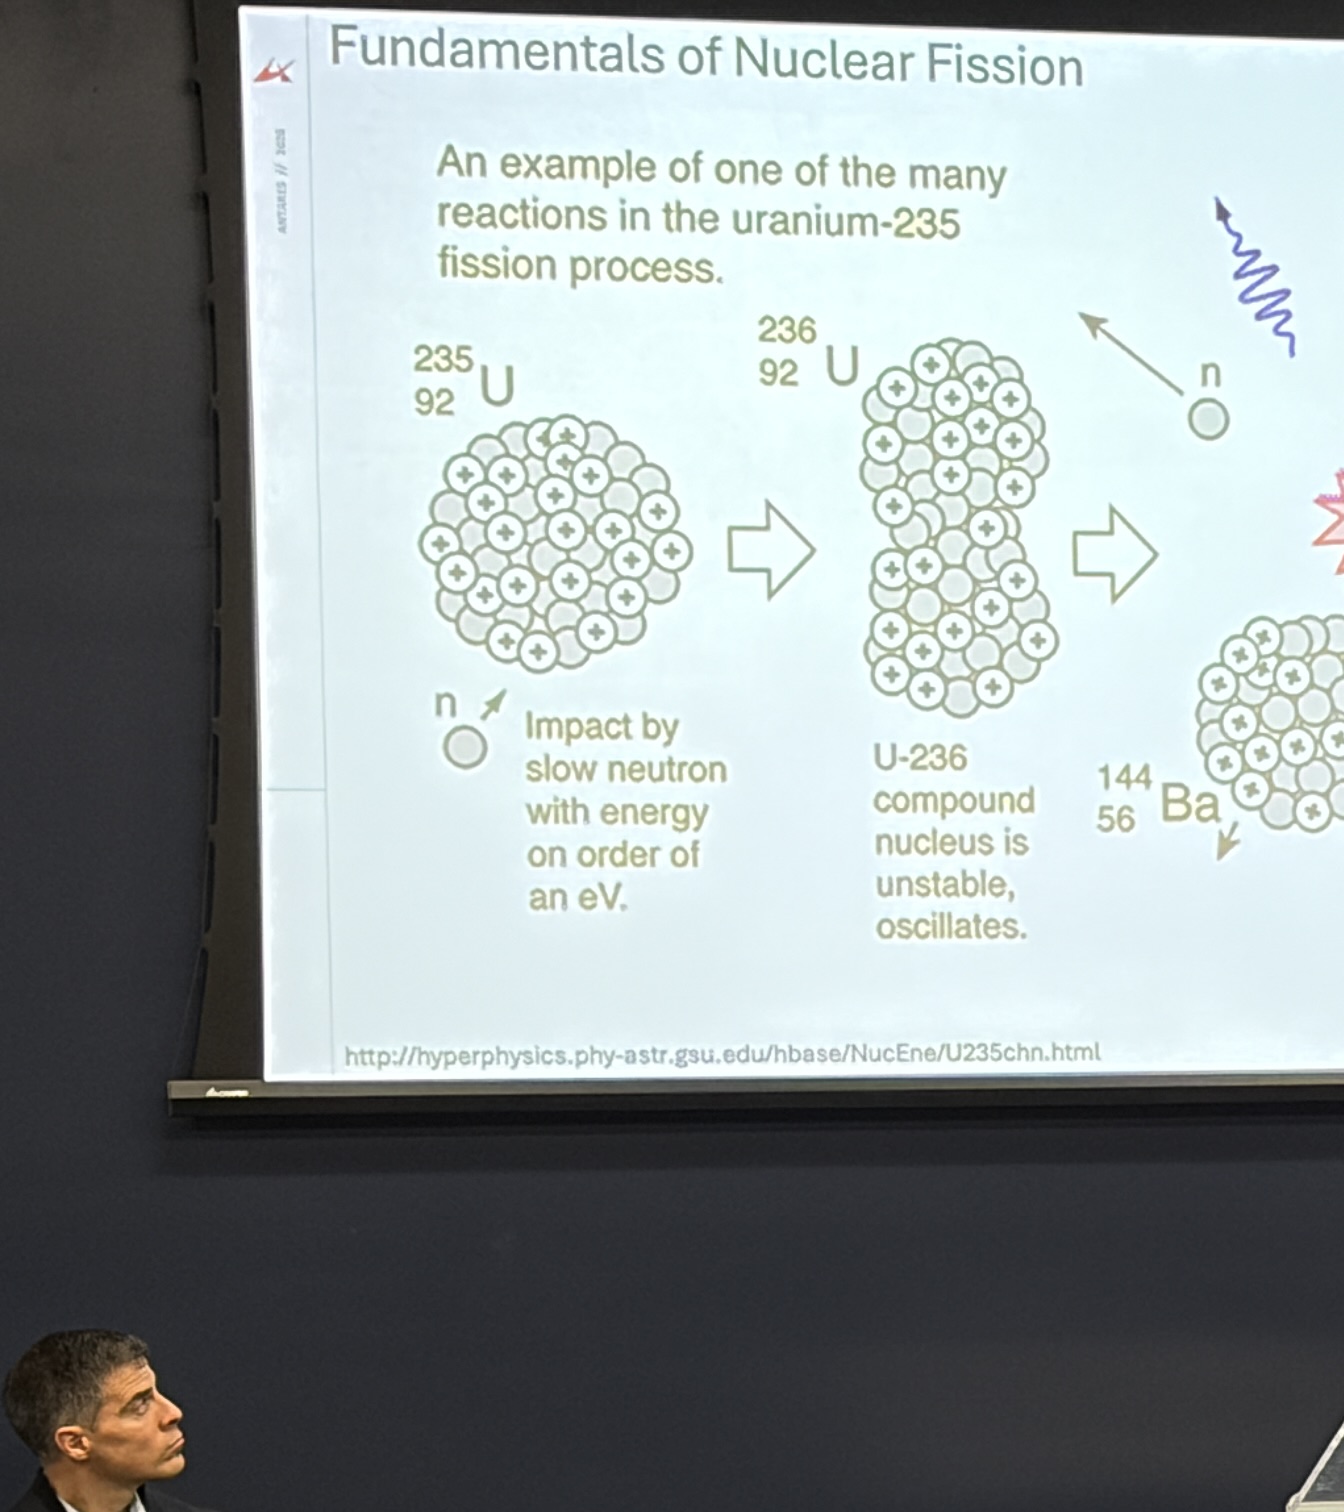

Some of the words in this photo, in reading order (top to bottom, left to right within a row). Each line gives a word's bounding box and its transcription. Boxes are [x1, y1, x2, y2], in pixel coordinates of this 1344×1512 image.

[331, 23, 665, 74] Fundamentals
[678, 35, 724, 76] of
[735, 36, 916, 82] Nuclear
[928, 42, 1083, 87] Fission
[437, 143, 487, 178] An
[500, 149, 656, 189] example
[669, 150, 704, 184] of
[714, 159, 783, 186] one
[795, 153, 829, 187] of
[839, 154, 896, 188] the
[909, 164, 1007, 199] many
[438, 194, 607, 232] reactions
[619, 197, 650, 232] in
[661, 198, 720, 234] the
[732, 202, 960, 240] uranium-235
[437, 244, 557, 280] fission
[569, 255, 723, 290] process.
[758, 314, 817, 344] 236
[414, 344, 474, 373] 235
[759, 357, 799, 387] 92
[826, 344, 858, 387] U
[414, 387, 455, 416] 92
[480, 364, 514, 407] U
[1201, 362, 1221, 387] n
[435, 692, 457, 718] n
[526, 710, 633, 747] Impact
[642, 711, 679, 748] by
[526, 752, 598, 783] slow
[608, 755, 727, 783] neutron
[874, 742, 967, 771] U-236
[1099, 763, 1152, 791] 144
[525, 794, 591, 825] with
[600, 802, 709, 834] energy
[873, 785, 1035, 820] compound
[1097, 805, 1136, 833] 56
[1162, 782, 1222, 823] Ba
[527, 845, 567, 868] on
[576, 839, 662, 868] order
[670, 839, 700, 868] of
[876, 826, 995, 856] nucleus
[1004, 826, 1029, 856] is
[530, 888, 568, 912] an
[578, 881, 627, 911] eV.
[877, 868, 1015, 903] unstable,
[876, 910, 1027, 940] oscillates.
[346, 1042, 1101, 1071] http://hyperphysics.phy-astr.gsu.edu/hbase/NucEne/U235chn.html
